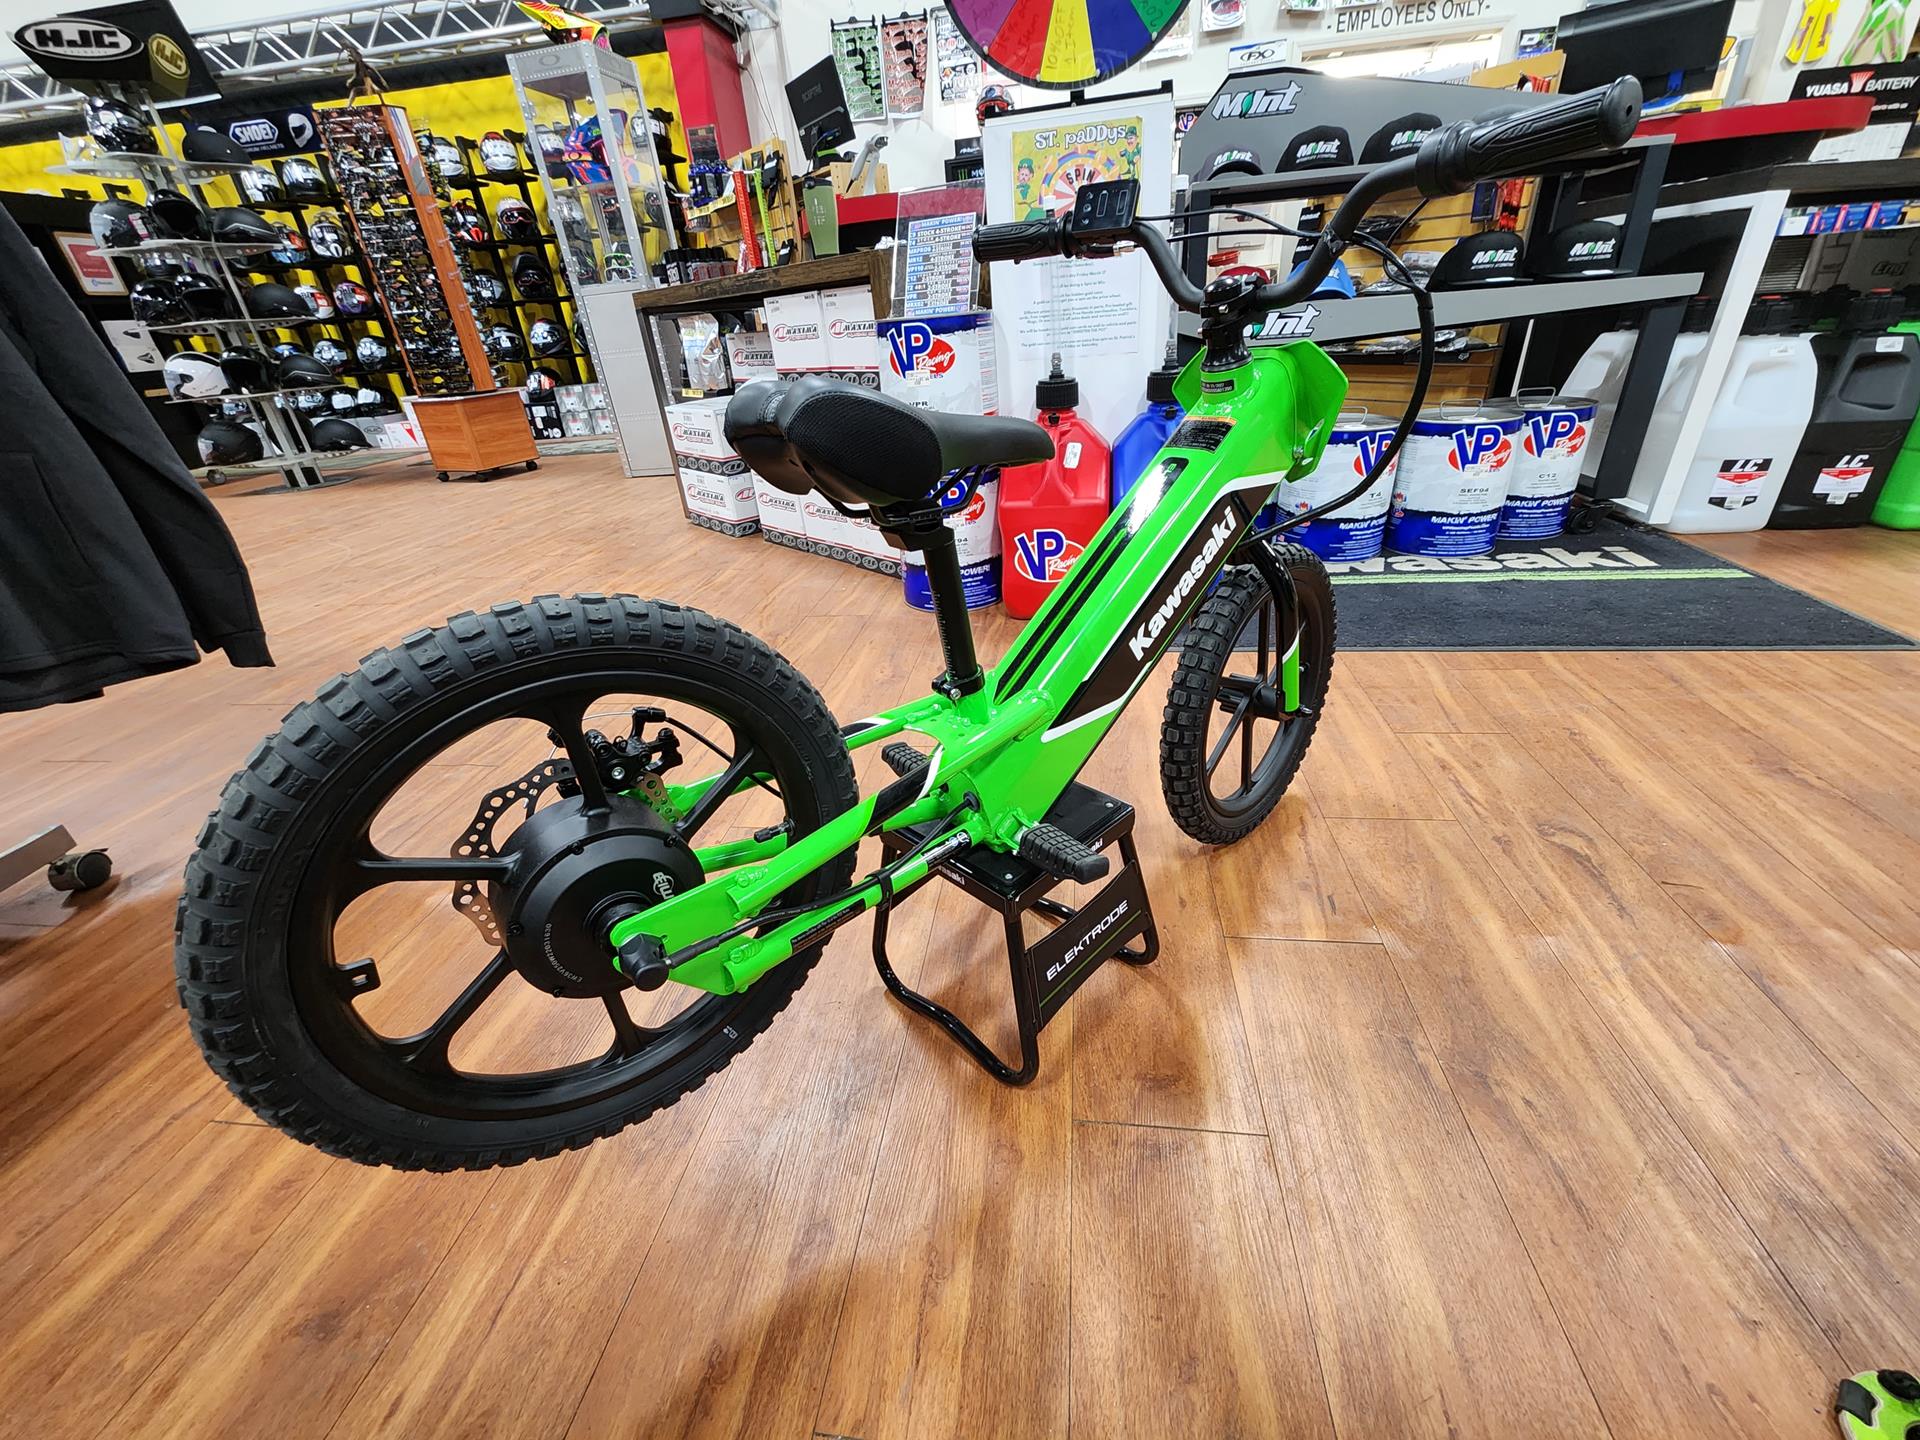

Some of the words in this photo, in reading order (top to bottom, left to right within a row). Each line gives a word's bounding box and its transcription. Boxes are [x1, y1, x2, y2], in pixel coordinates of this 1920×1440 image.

[1336, 2, 1436, 33] EMPLOYEES
[34, 29, 120, 49] HJC
[155, 40, 183, 71] HJC
[1806, 82, 1849, 97] YUASA
[1864, 76, 1920, 92] BATTERY
[234, 123, 274, 143] SHOEI
[1034, 129, 1061, 149] ST.
[1066, 167, 1096, 185] SPIN
[843, 321, 874, 332] MAXIM
[887, 322, 933, 380] VP
[916, 350, 956, 372] Racing
[1528, 412, 1578, 459] VP
[1452, 425, 1503, 473] VP
[1730, 459, 1764, 472] LC
[1835, 454, 1870, 468] LC
[1369, 491, 1382, 499] T4
[1431, 515, 1467, 525] MAKIN'
[1014, 528, 1067, 581] VP
[1128, 505, 1238, 662] Kawasaki
[1046, 899, 1130, 982] ELEKTRODE
